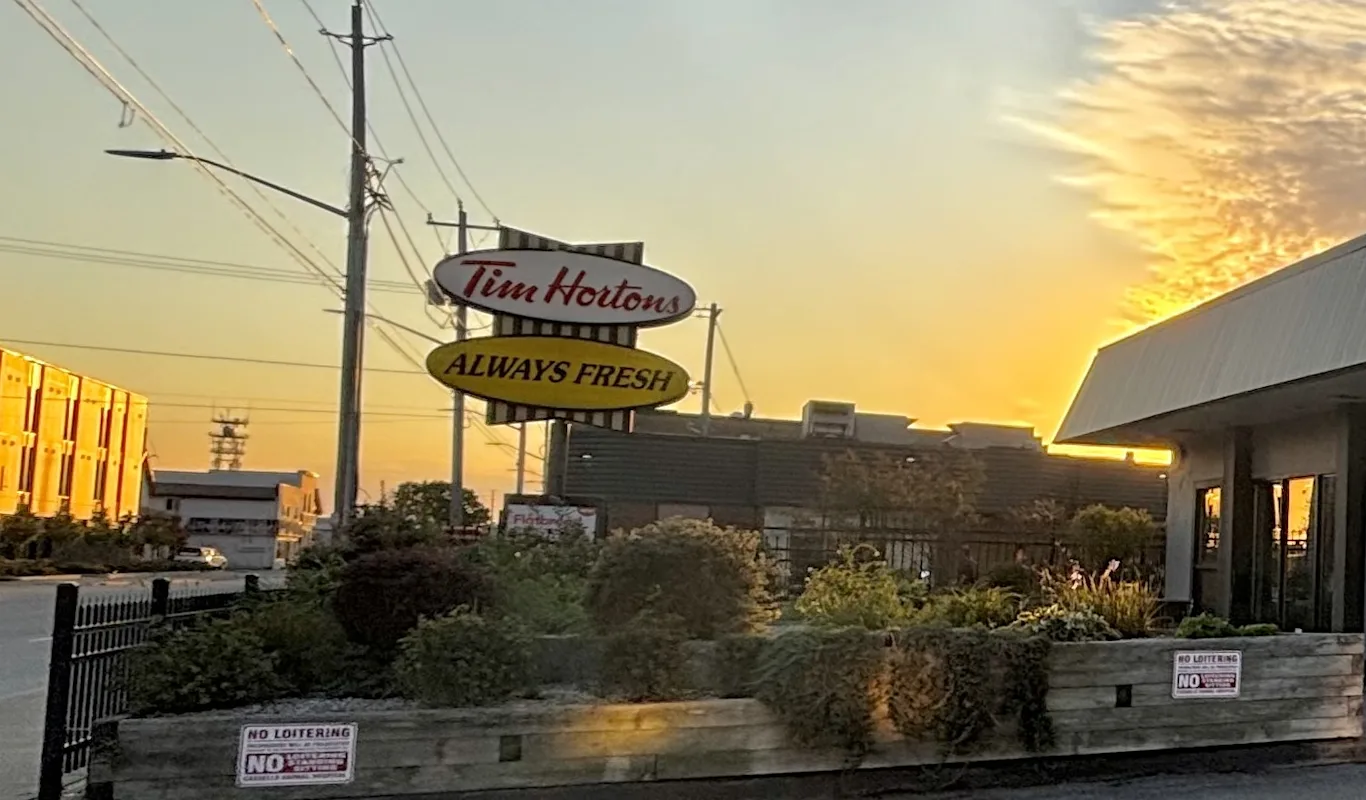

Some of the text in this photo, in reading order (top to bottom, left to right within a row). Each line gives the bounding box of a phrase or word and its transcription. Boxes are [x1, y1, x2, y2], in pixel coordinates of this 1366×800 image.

[460, 260, 680, 314] Tim Hortons
[444, 353, 676, 392] ALWAYS FRESH
[1178, 655, 1238, 663] NO LOITERING
[1178, 674, 1200, 688] NO
[248, 728, 350, 739] NO LOITERING
[247, 754, 284, 773] NO
